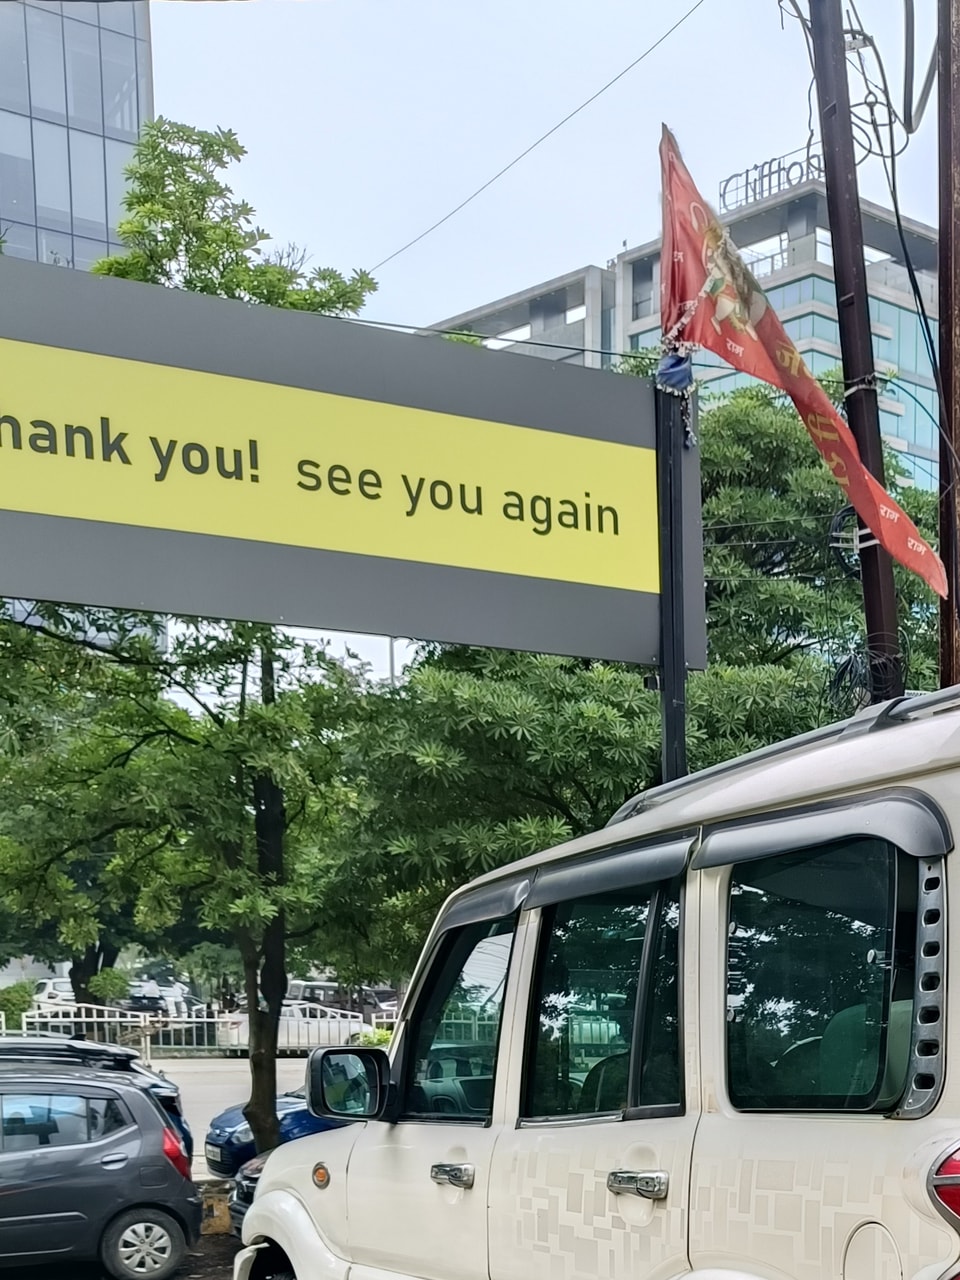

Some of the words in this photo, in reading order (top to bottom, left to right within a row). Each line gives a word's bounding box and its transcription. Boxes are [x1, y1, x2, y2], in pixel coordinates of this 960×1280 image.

[148, 435, 260, 484] you!
[296, 459, 383, 501] see
[400, 473, 483, 518] you
[502, 490, 619, 536] again
